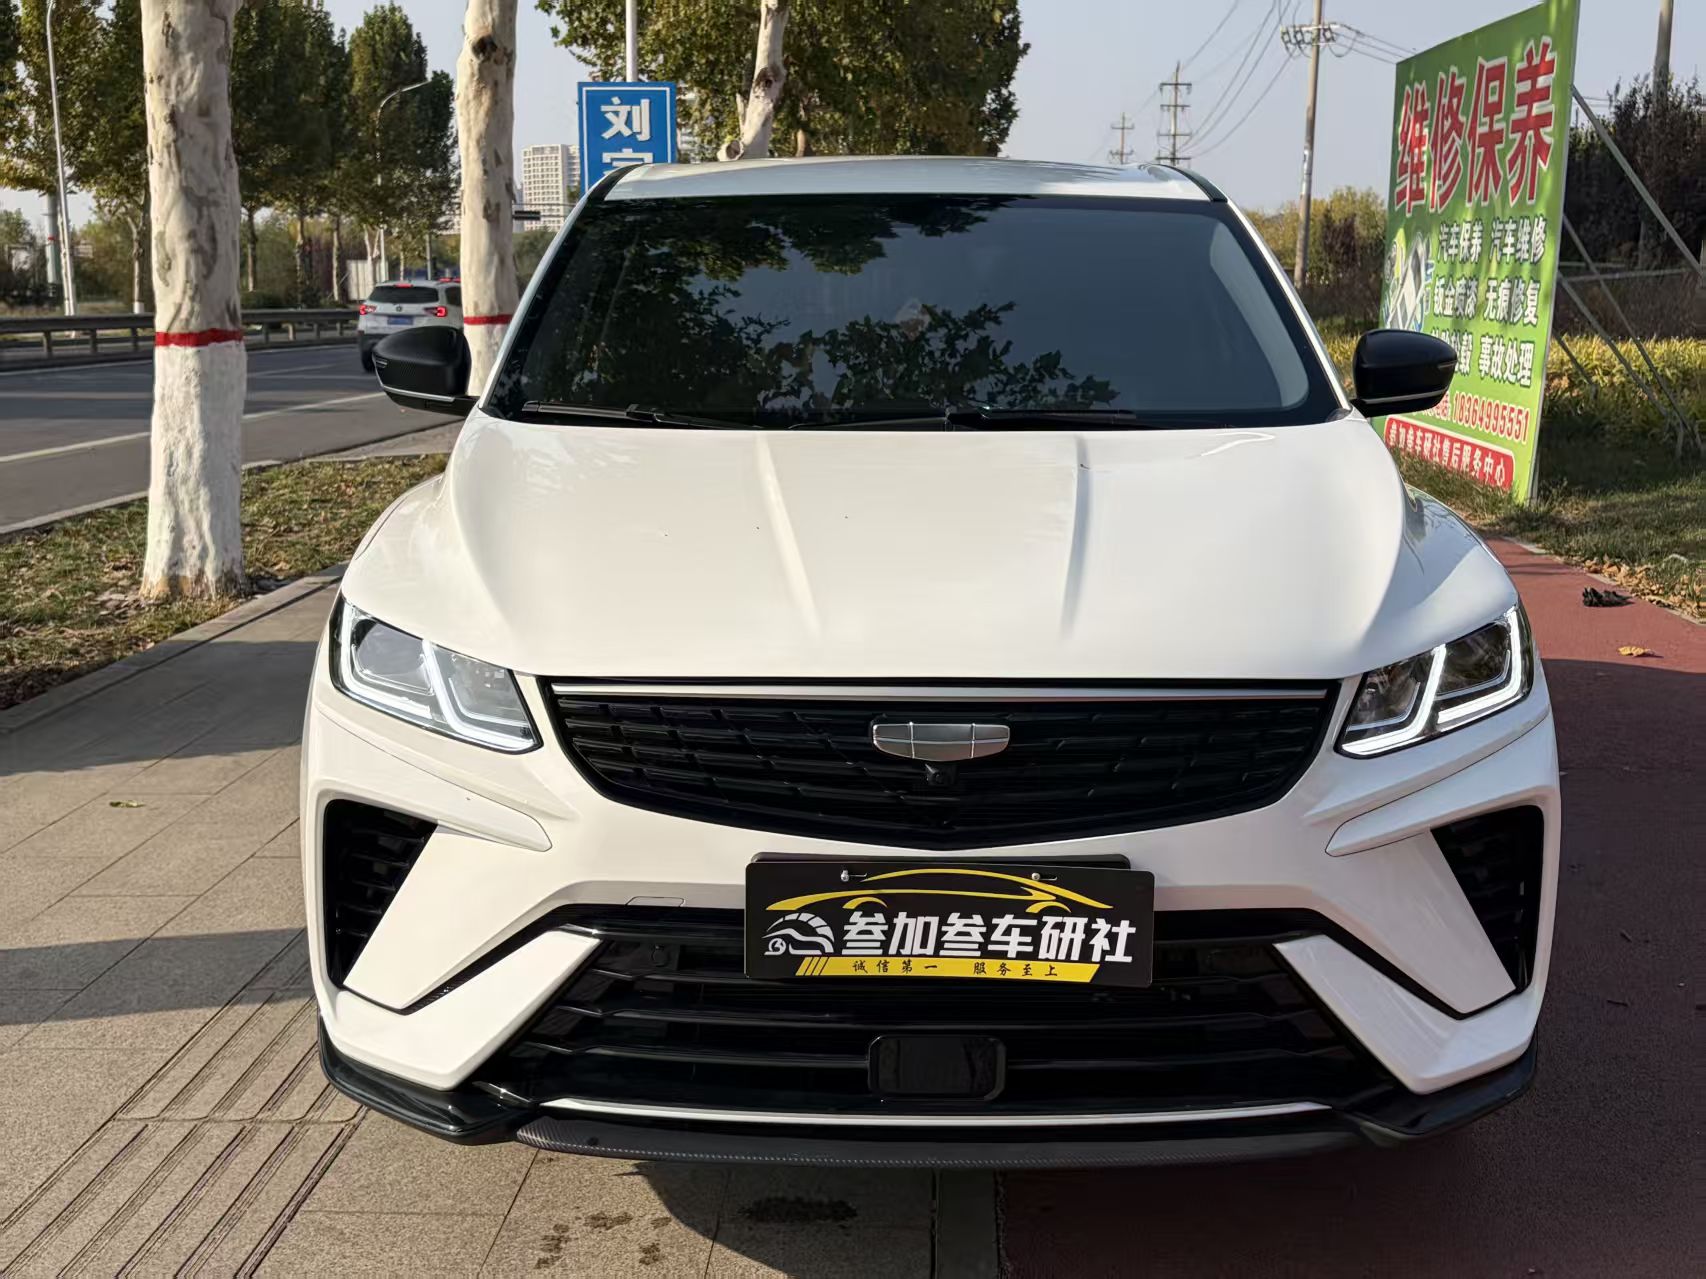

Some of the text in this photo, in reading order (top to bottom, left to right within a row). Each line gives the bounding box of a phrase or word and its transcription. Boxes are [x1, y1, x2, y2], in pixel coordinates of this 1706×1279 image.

[1395, 36, 1557, 216] 维修保养
[1437, 216, 1546, 262] 汽车保养 汽车维修
[1433, 276, 1540, 325] 钣金喷漆 无痕修复
[1431, 328, 1534, 387] 轮毂 事故处理
[1453, 391, 1530, 445] 18364995551
[842, 911, 1136, 962] 叁加叁车研社
[852, 959, 1058, 977] 诚信第一 服务至上
